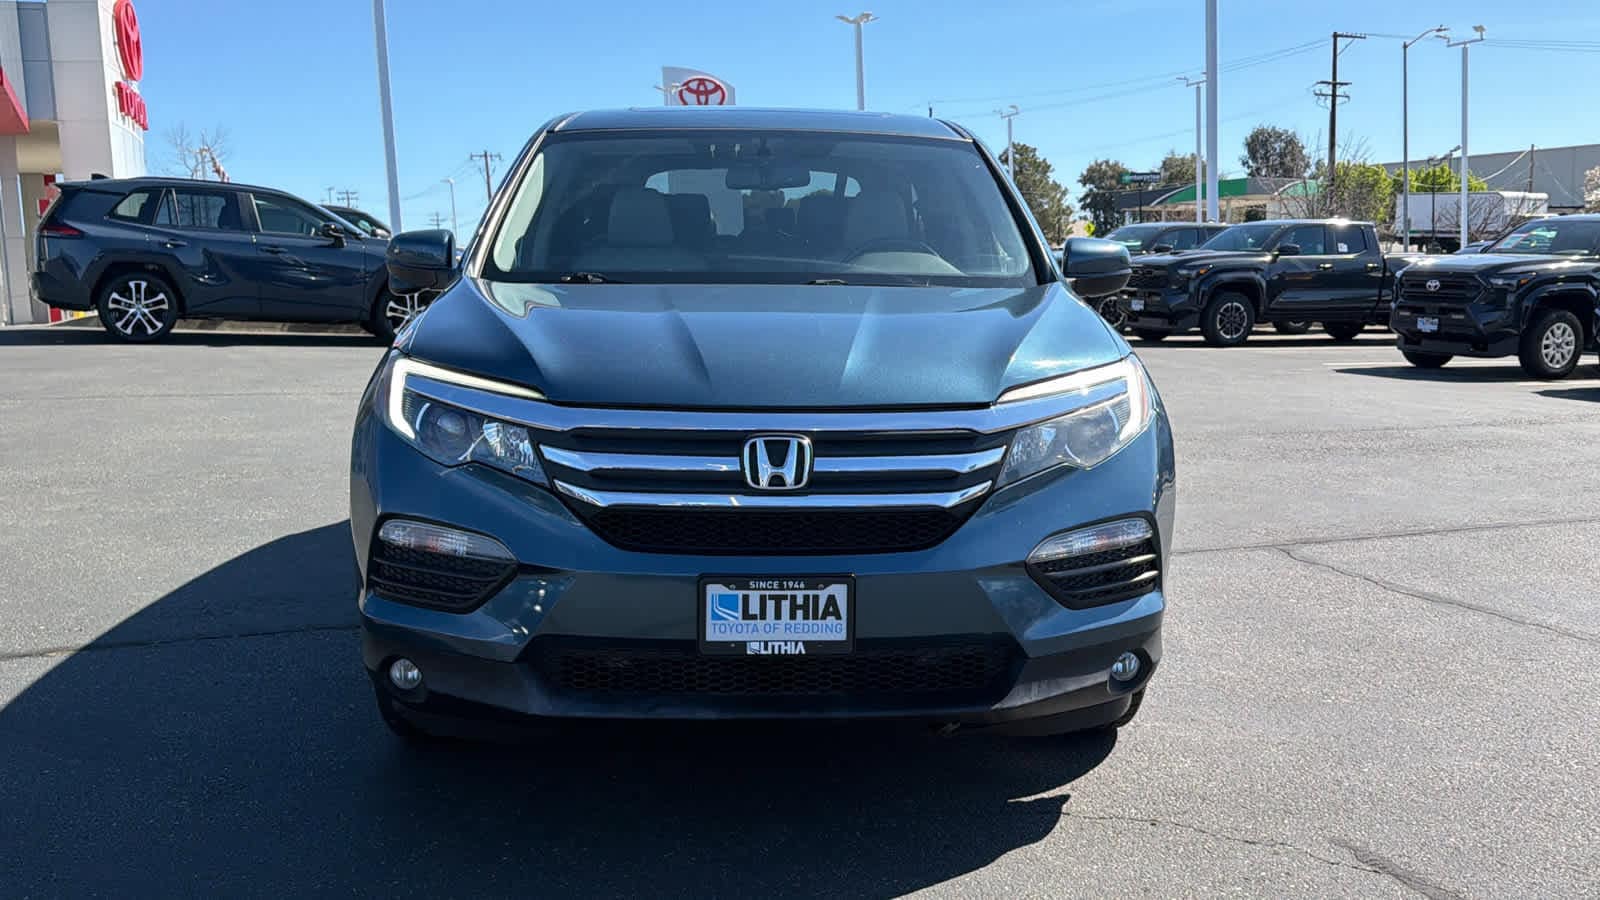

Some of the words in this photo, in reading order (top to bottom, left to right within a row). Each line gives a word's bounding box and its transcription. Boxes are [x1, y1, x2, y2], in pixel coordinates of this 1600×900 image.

[749, 581, 779, 589] SINCE
[782, 581, 805, 589] 1946
[741, 594, 843, 621] LITHIA
[712, 623, 760, 634] TOYOTA
[763, 623, 780, 634] OF
[784, 623, 843, 634] REDDING
[760, 641, 806, 655] LITHIA
